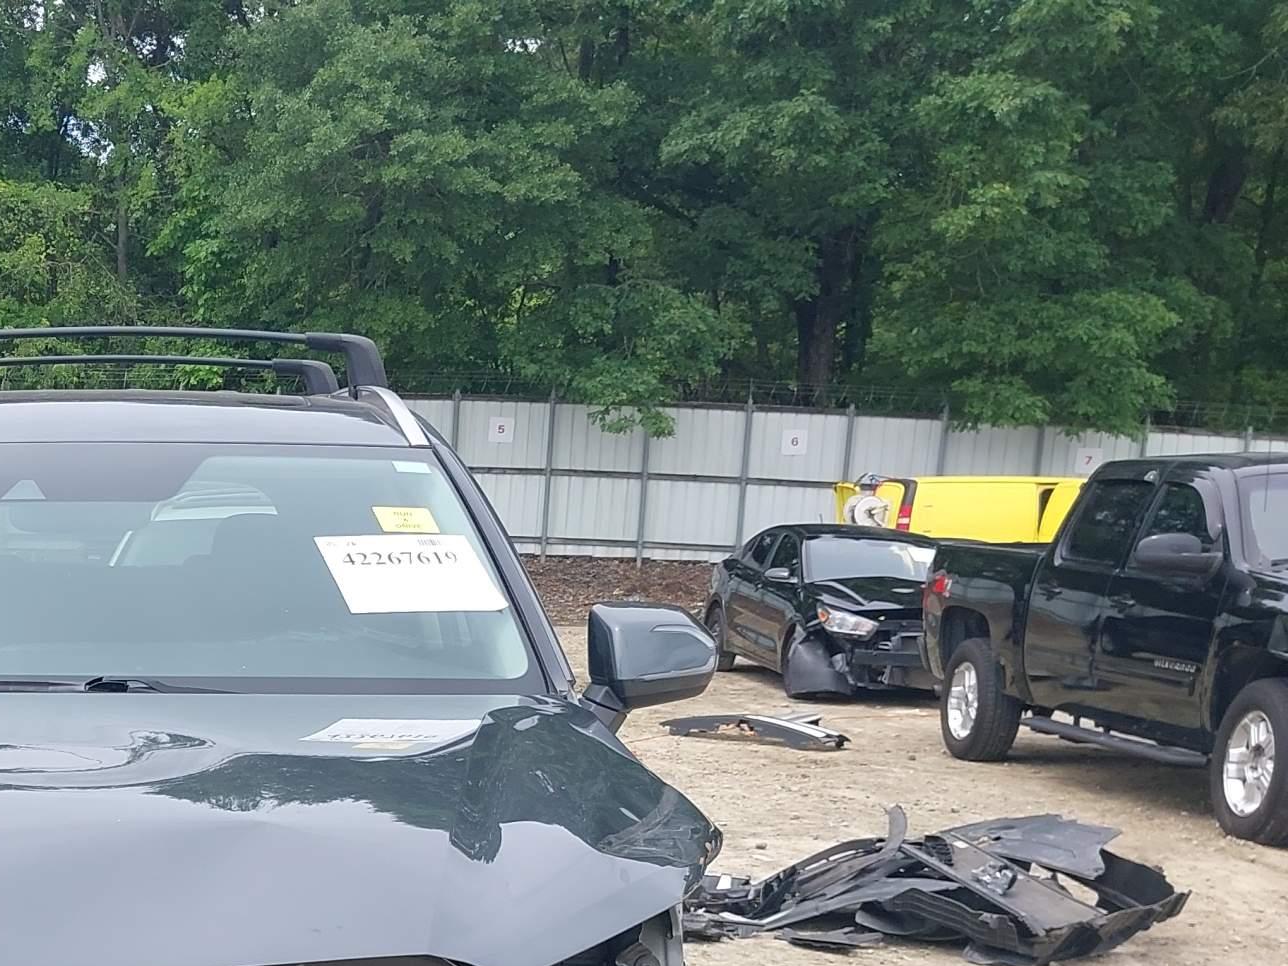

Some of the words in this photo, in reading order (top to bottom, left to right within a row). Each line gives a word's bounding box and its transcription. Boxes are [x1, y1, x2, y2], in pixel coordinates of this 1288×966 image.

[498, 424, 505, 434] 5
[792, 436, 799, 447] 6
[1085, 455, 1093, 465] 7
[343, 552, 457, 565] 42267619
